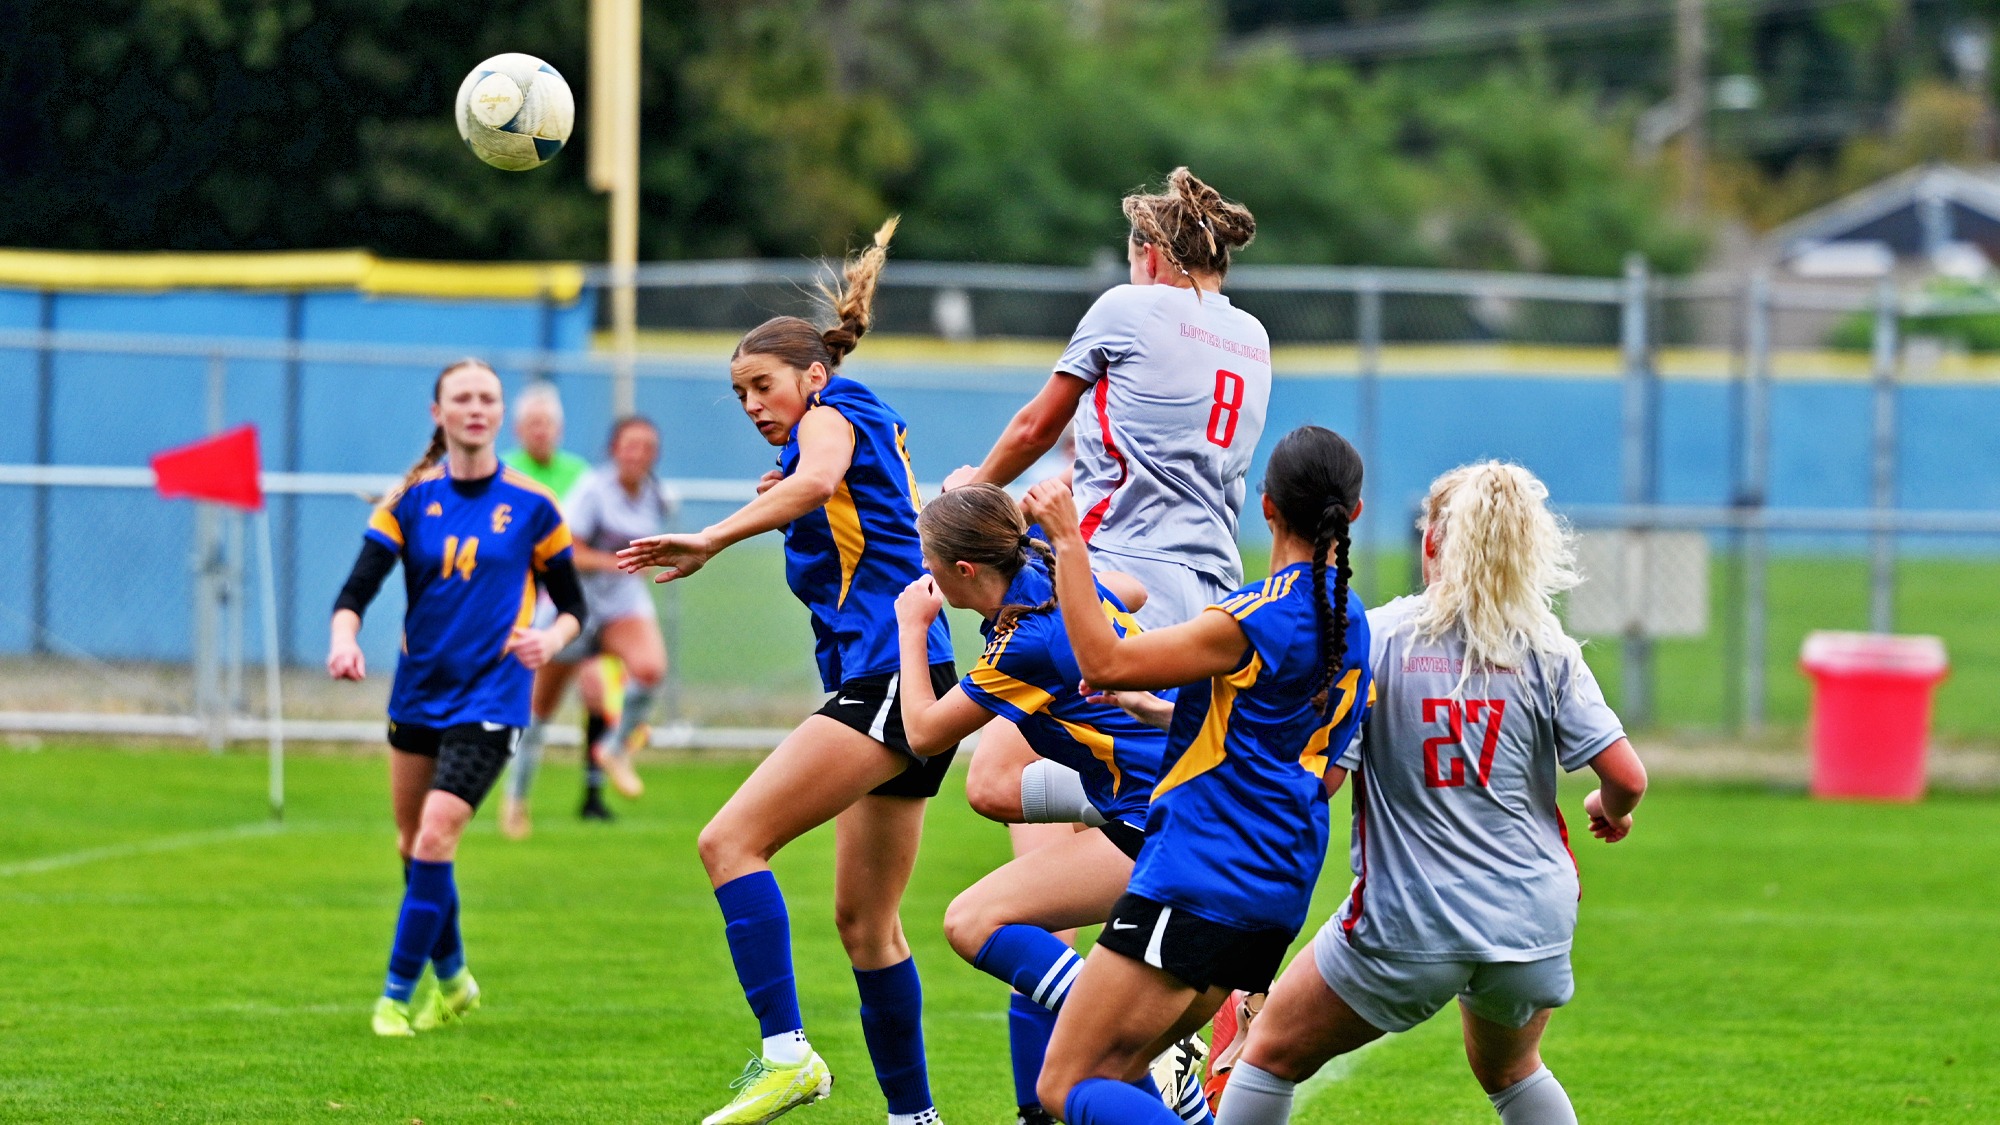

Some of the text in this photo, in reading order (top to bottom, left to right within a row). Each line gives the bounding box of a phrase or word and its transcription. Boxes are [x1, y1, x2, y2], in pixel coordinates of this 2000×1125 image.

[1180, 323, 1221, 348] LOWER
[1206, 369, 1245, 449] 8
[442, 535, 479, 582] 14
[1422, 698, 1506, 788] 27
